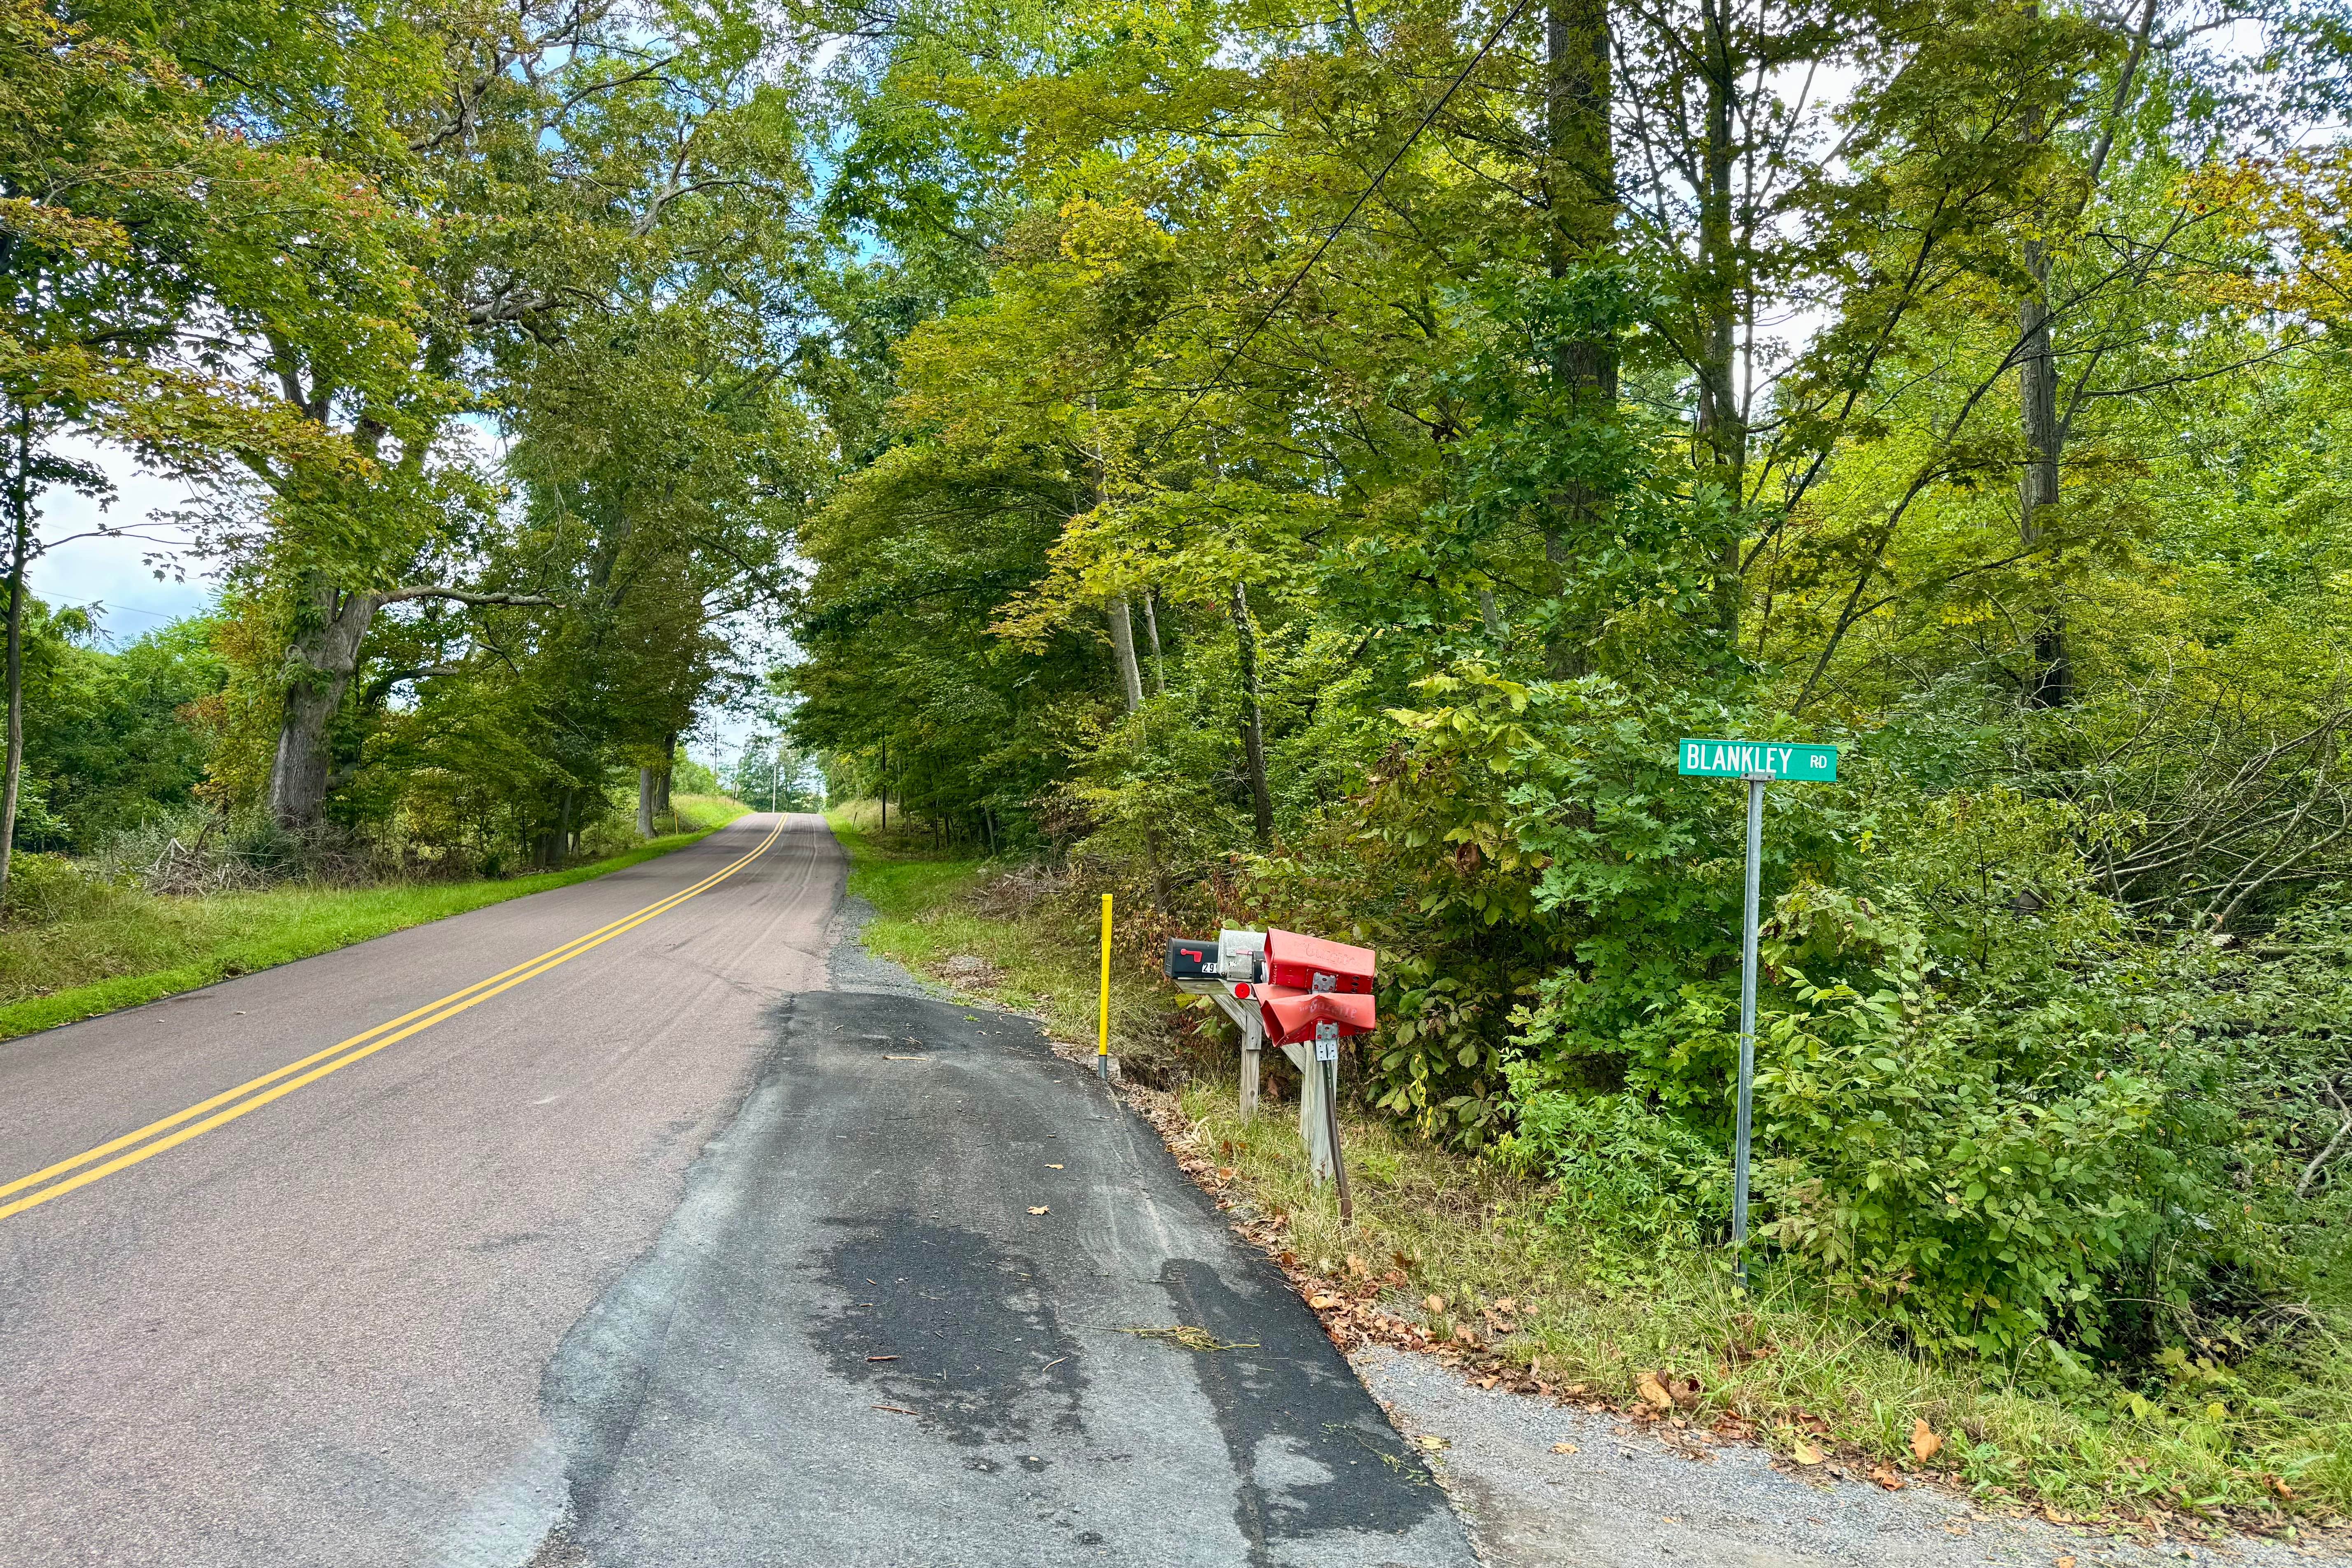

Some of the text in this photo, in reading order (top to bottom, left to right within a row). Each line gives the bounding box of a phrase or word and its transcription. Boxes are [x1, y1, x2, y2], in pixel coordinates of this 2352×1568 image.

[1687, 744, 1827, 774] BLANKLEY RD
[1203, 963, 1218, 972] 29
